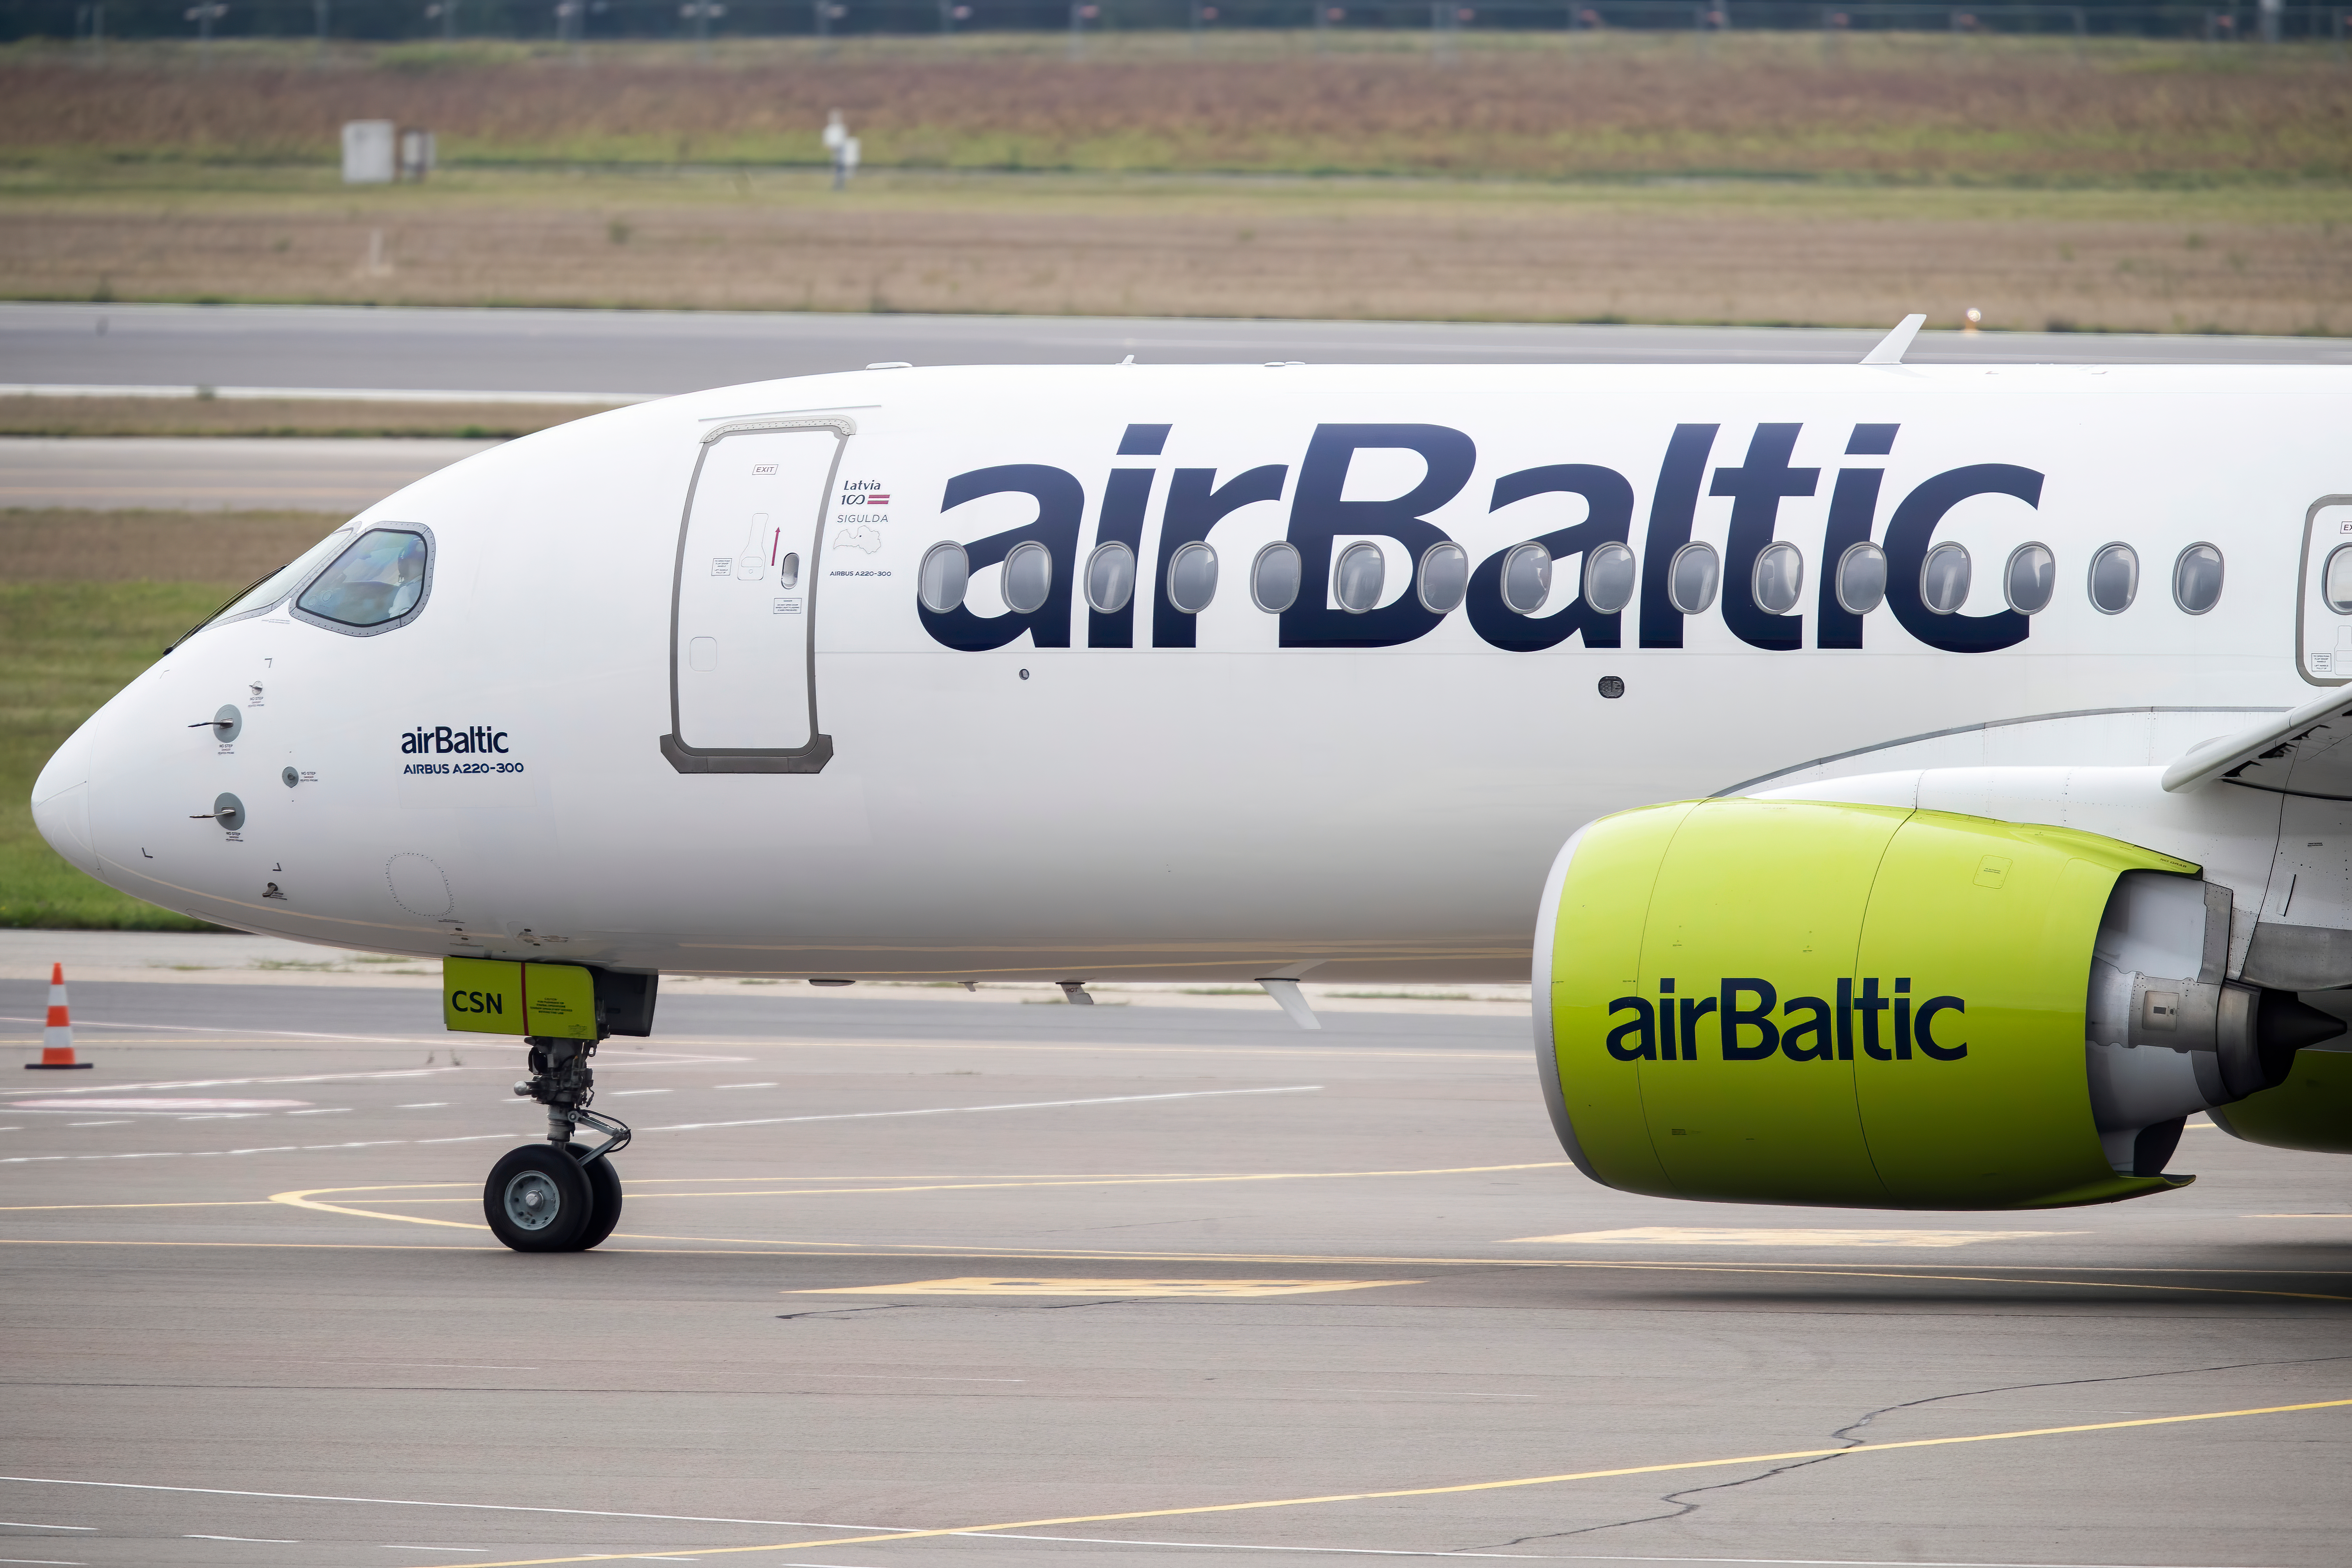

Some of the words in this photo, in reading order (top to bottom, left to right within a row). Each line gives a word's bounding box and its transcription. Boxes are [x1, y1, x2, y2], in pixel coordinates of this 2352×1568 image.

[844, 480, 881, 491] Latvia
[837, 514, 888, 523] SIGULDA
[917, 423, 2046, 653] airBaltic
[401, 726, 509, 754] airBaltic
[403, 764, 450, 774] AIRBUS
[453, 762, 524, 774] A220-300
[452, 990, 503, 1015] CSN
[1606, 978, 1968, 1062] airBaltic
